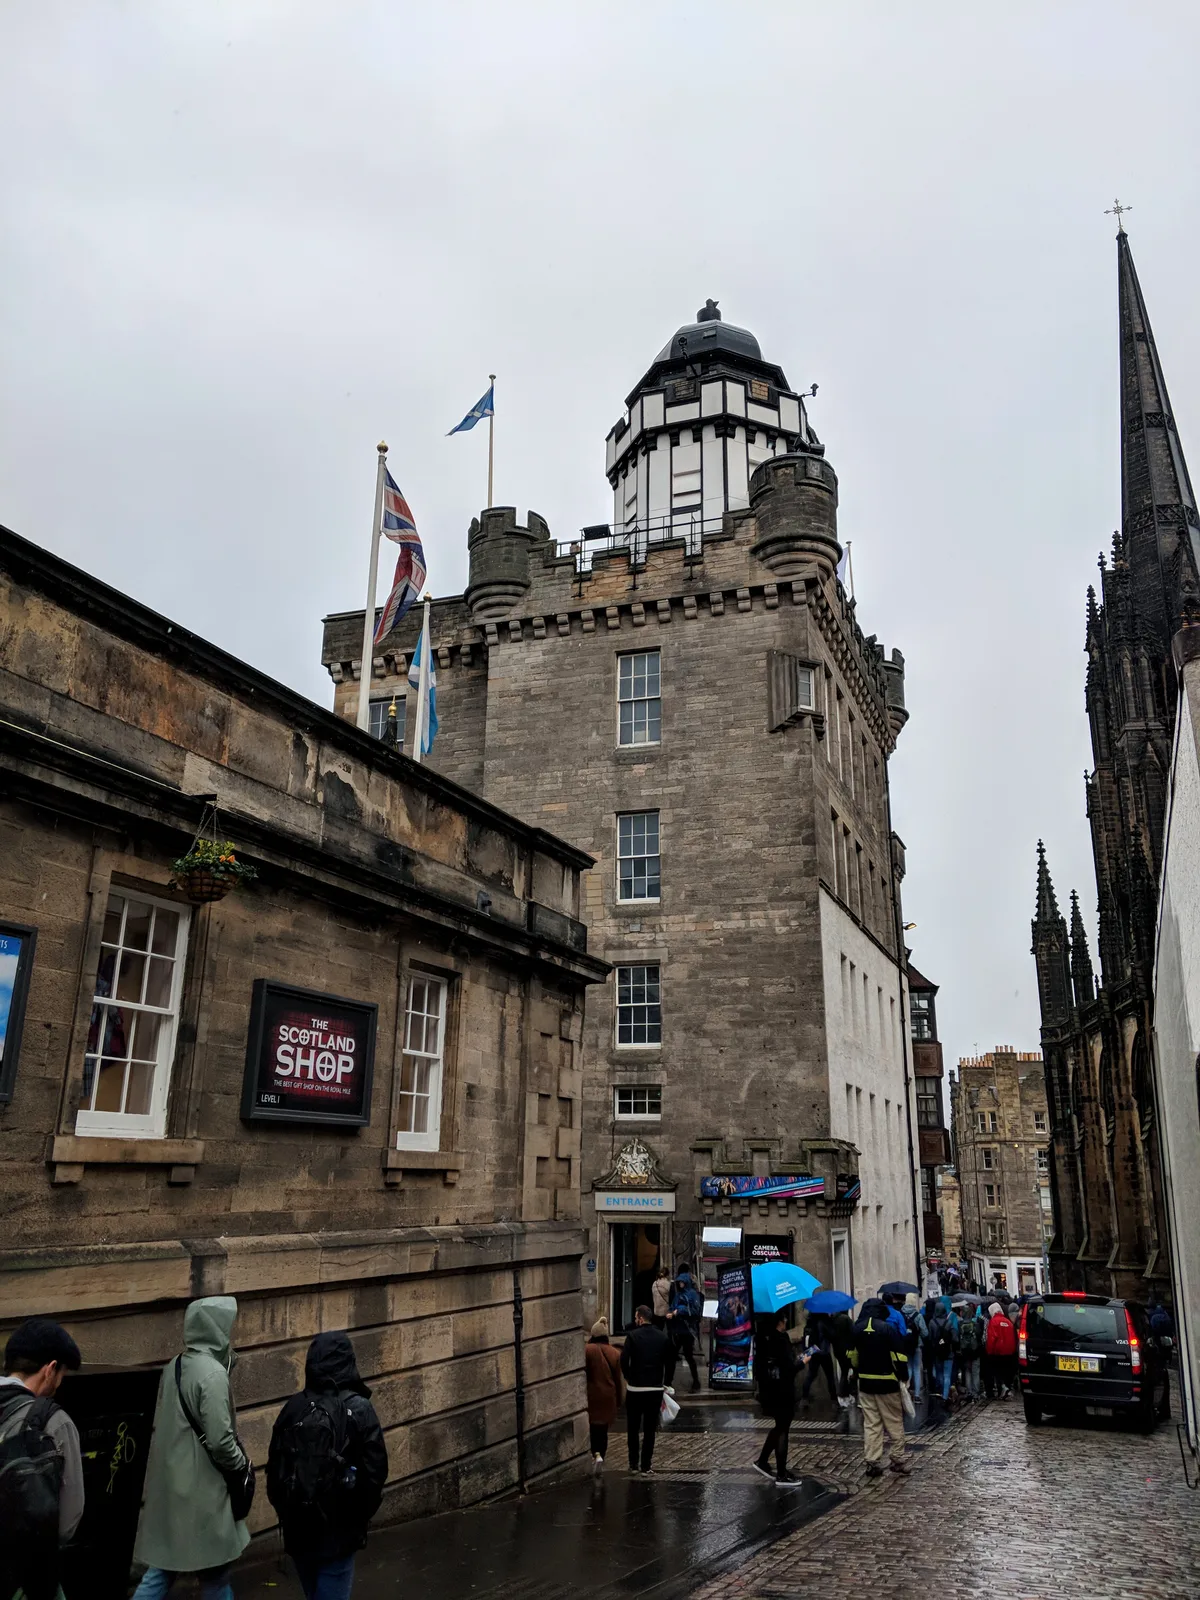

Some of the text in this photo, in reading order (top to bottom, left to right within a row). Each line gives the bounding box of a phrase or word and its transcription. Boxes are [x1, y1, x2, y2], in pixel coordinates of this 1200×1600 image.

[311, 1018, 329, 1030] THE
[278, 1024, 356, 1053] SCOTLAND
[275, 1043, 354, 1083] SHOP
[273, 1079, 282, 1087] THE
[330, 1086, 342, 1094] ROYAL
[261, 1094, 277, 1103] LEVEL
[605, 1197, 664, 1206] ENTRANCE
[721, 1275, 745, 1285] OBSCURA
[722, 1270, 743, 1279] CAMERA
